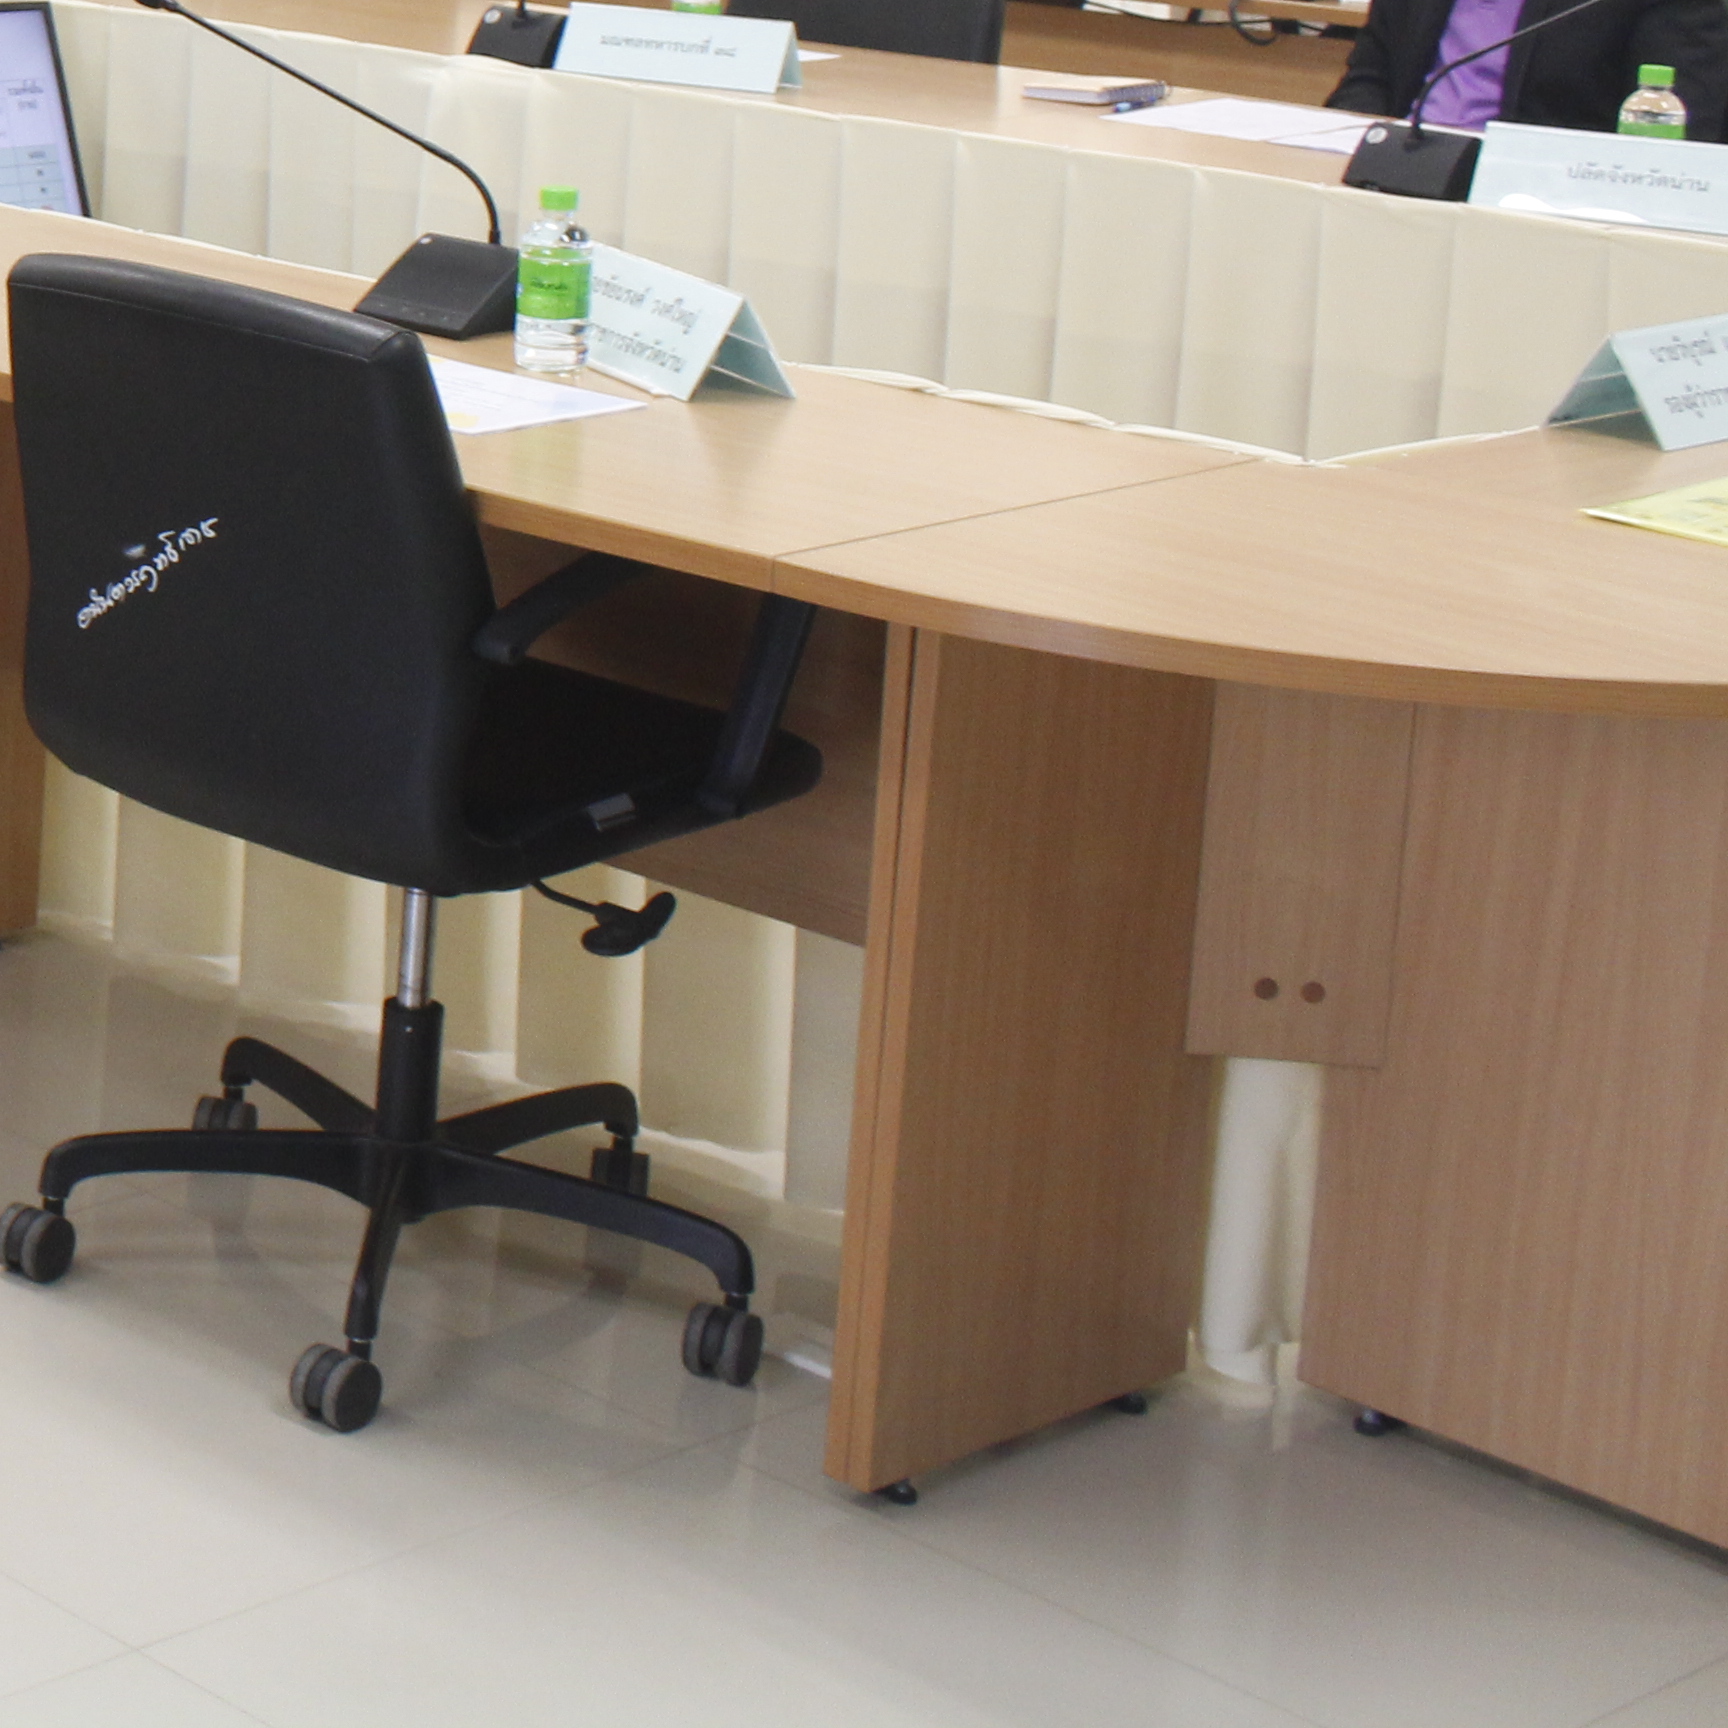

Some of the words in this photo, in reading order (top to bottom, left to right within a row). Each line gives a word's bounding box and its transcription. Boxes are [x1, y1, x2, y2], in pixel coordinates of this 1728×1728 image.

[1566, 161, 1712, 193] ปลัดจังหวัดน่าน
